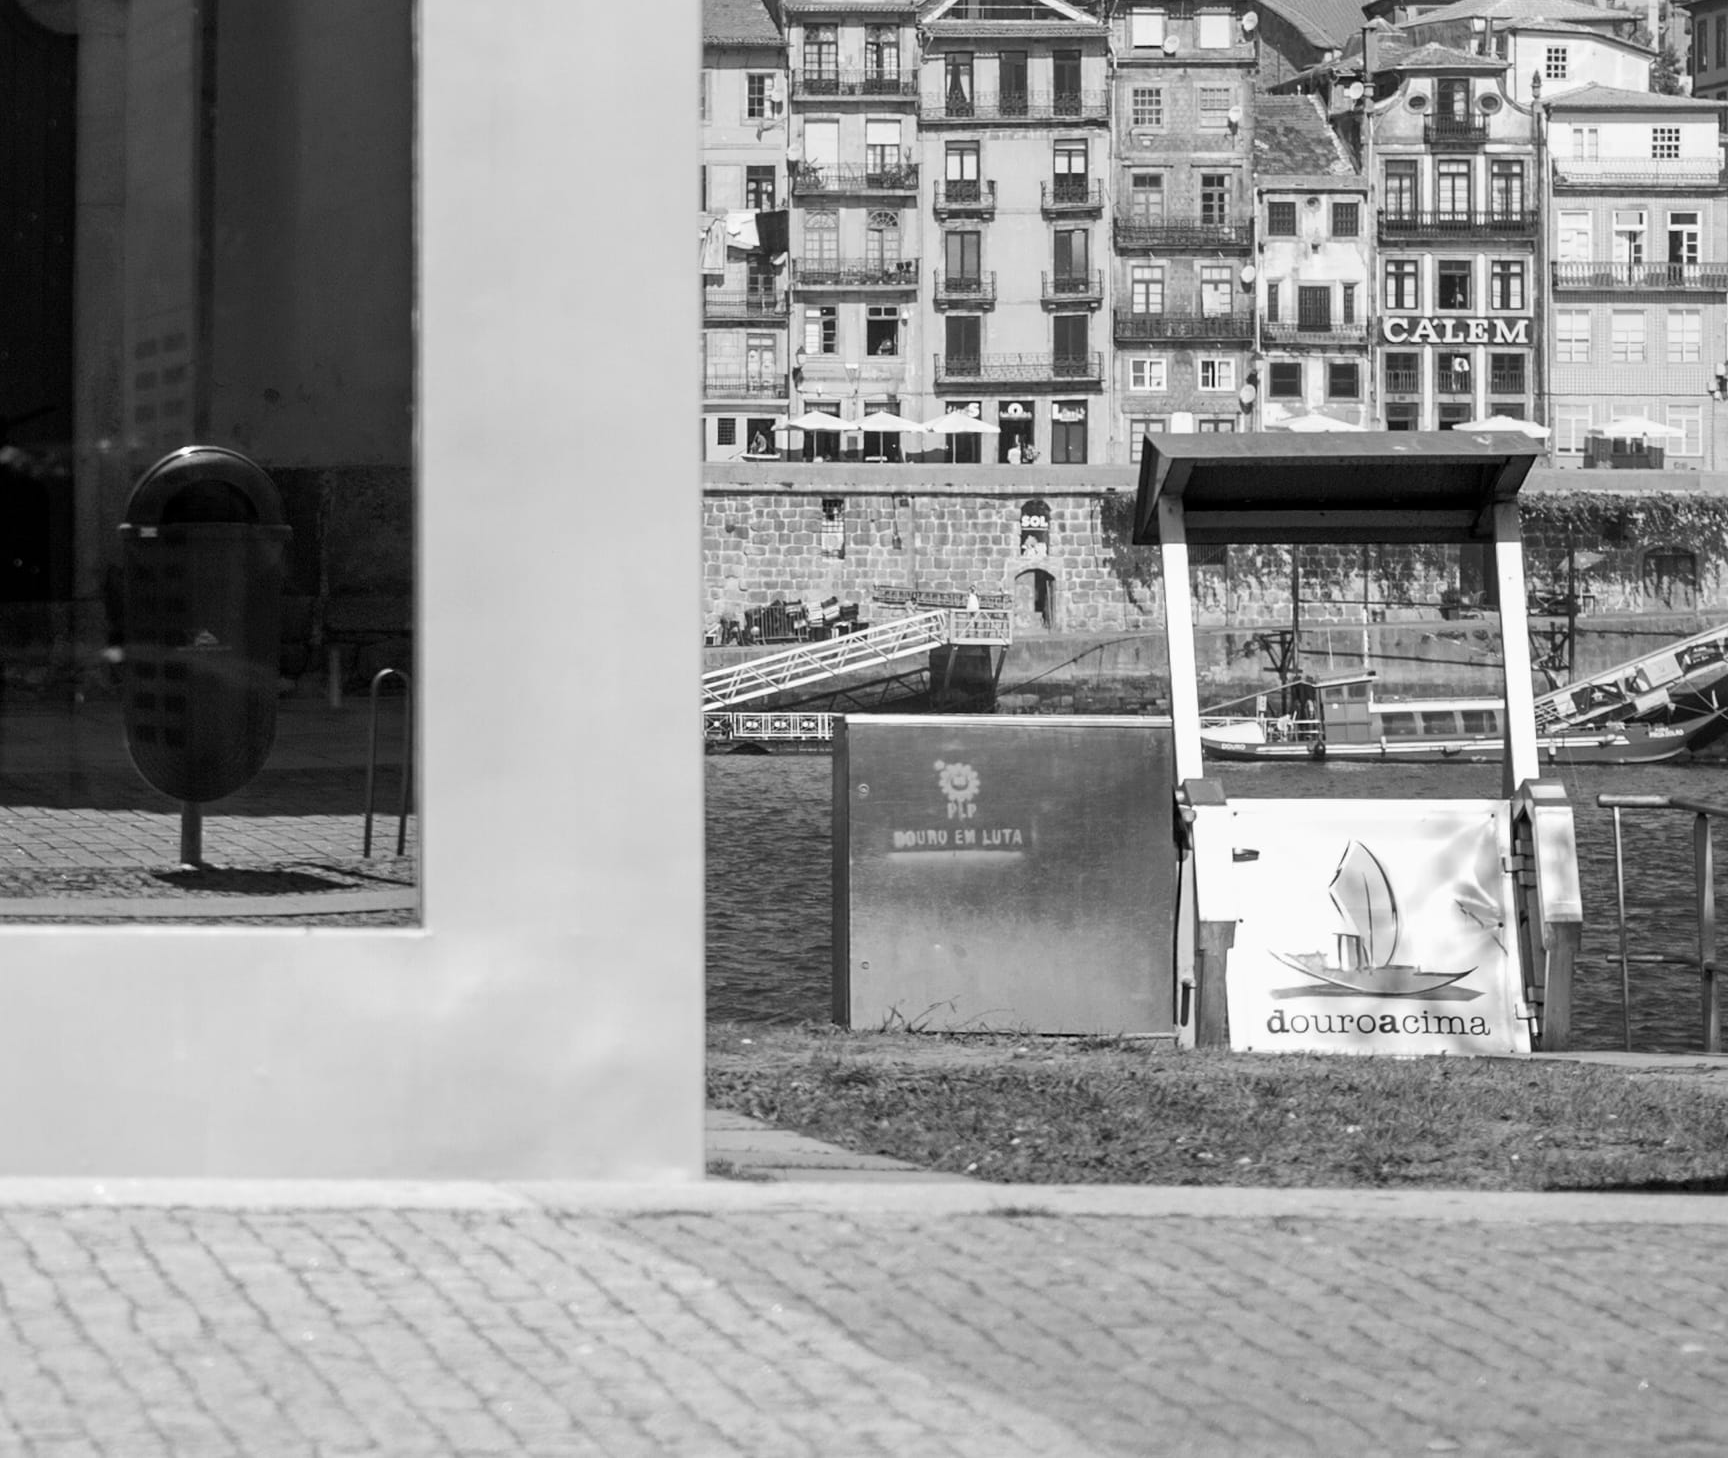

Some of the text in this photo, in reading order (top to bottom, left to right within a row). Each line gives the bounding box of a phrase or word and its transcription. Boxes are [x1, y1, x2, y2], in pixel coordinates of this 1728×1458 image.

[1021, 515, 1049, 527] SOL
[947, 802, 977, 820] PLP
[894, 828, 1023, 848] DOURO EM LUTA
[1266, 1009, 1492, 1036] douroacima
